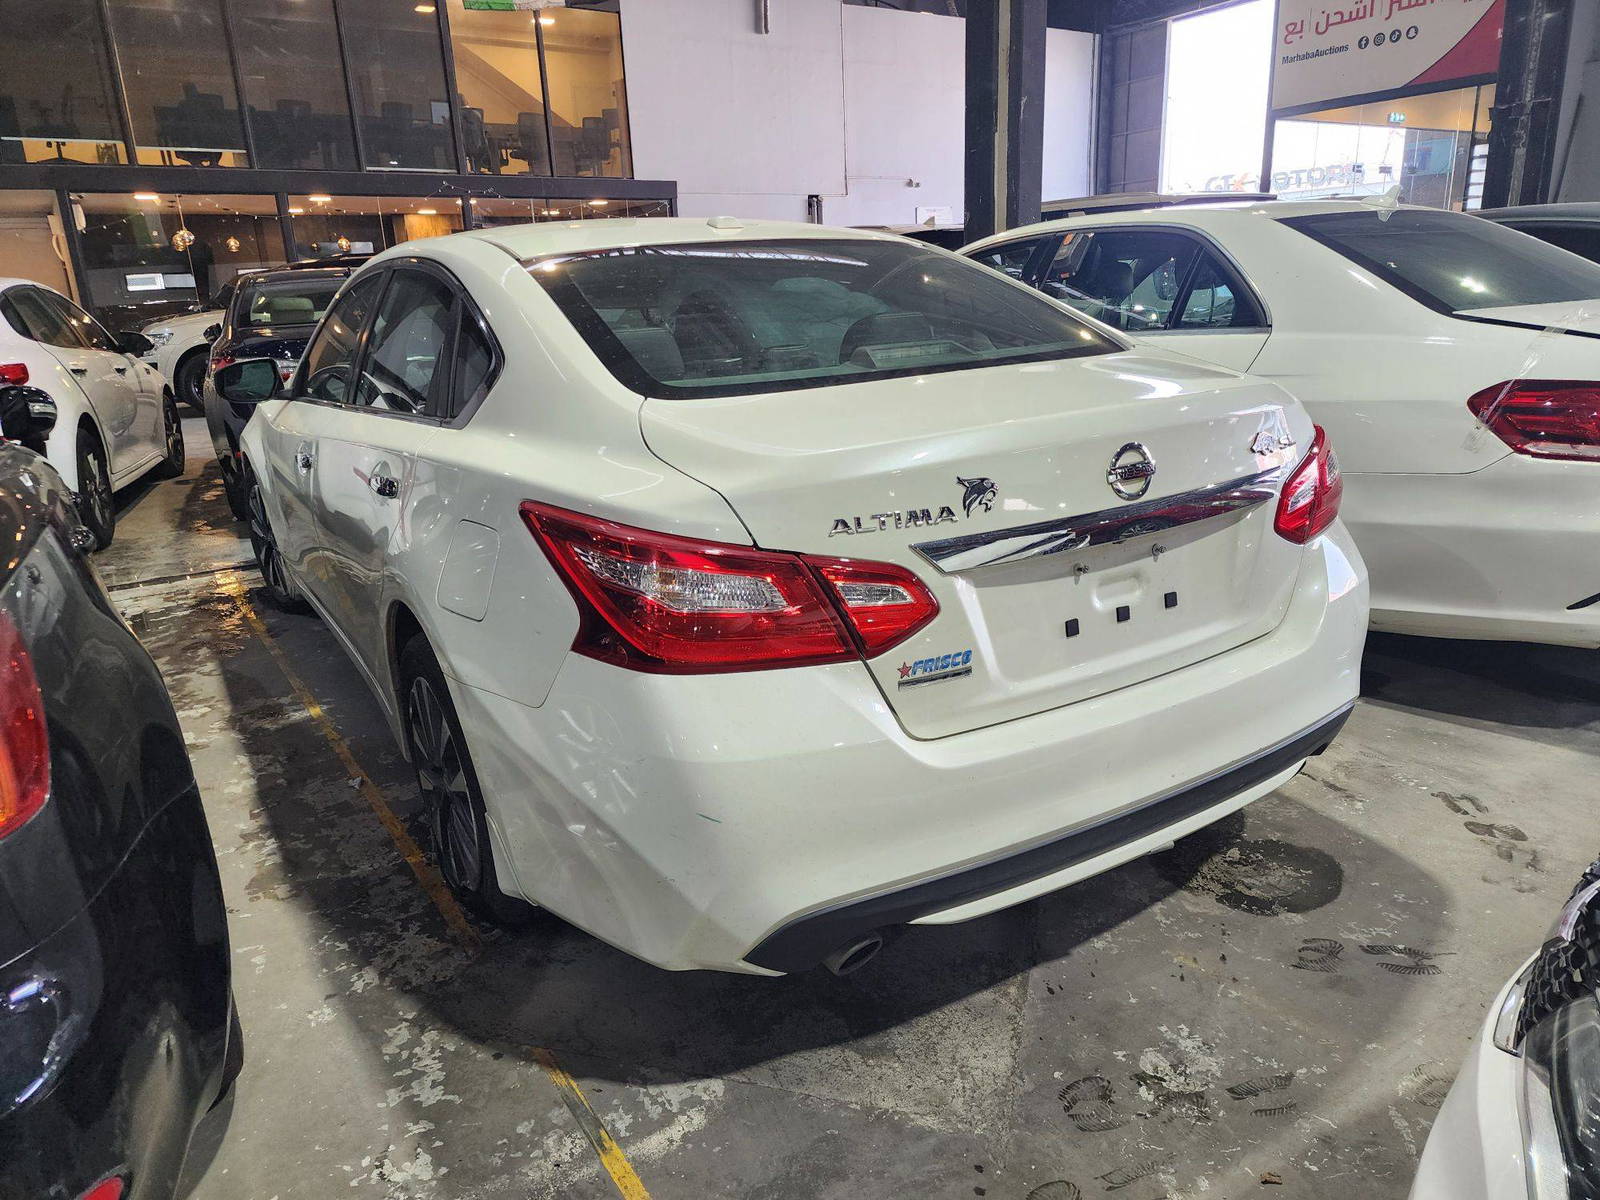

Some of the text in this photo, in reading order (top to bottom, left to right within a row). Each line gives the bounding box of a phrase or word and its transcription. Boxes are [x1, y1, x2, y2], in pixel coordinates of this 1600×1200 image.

[1315, 0, 1375, 36] اشحن
[1284, 19, 1304, 45] بع
[1281, 44, 1350, 65] MarhabaAuctions
[828, 506, 959, 538] ALTIMA
[911, 650, 972, 676] FRISCO
